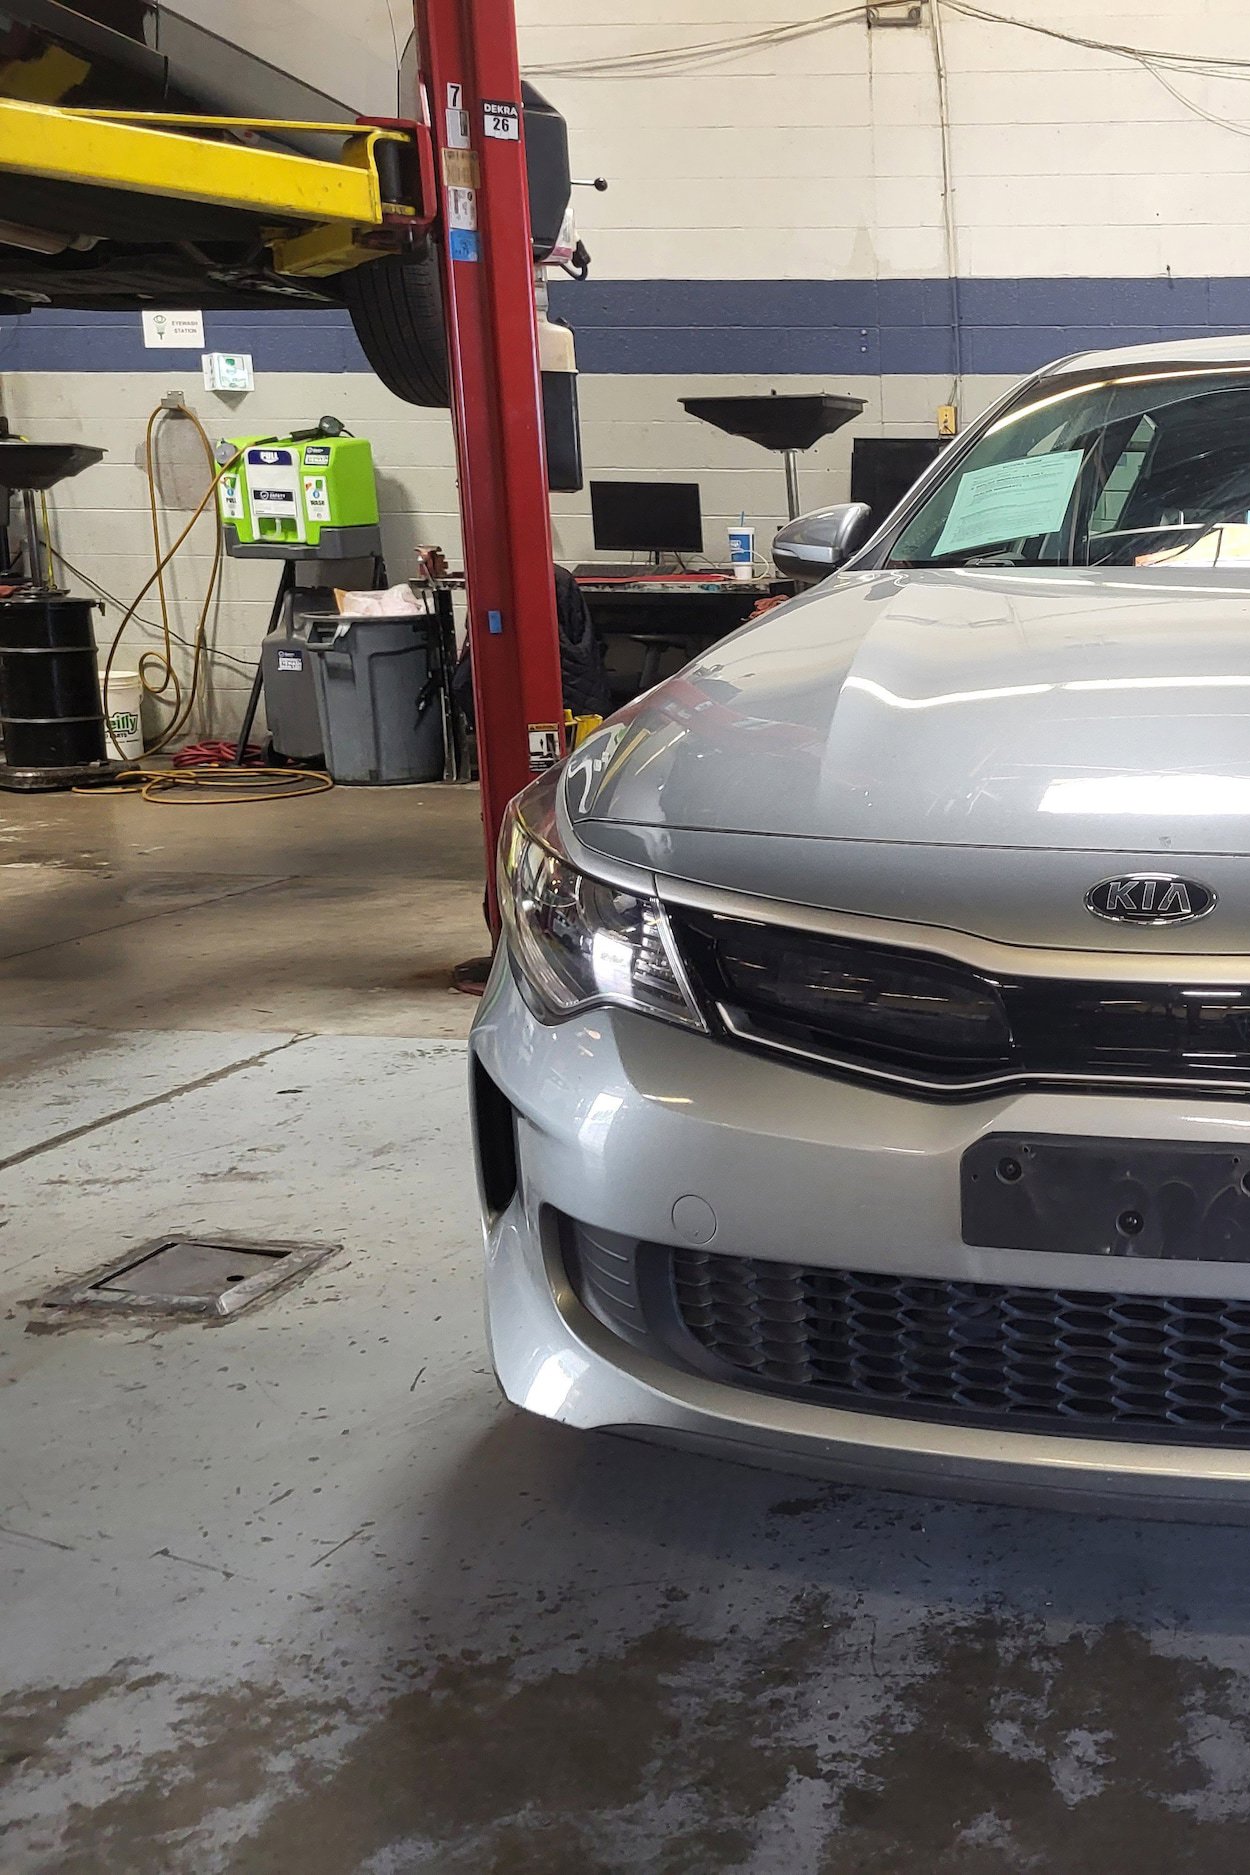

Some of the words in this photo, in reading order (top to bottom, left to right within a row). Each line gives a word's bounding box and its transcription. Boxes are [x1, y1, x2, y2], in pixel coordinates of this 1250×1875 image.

[450, 85, 460, 107] 7
[483, 103, 518, 117] DEKRA
[493, 117, 510, 132] 26
[110, 715, 136, 731] eilly
[1106, 880, 1192, 913] KIA
